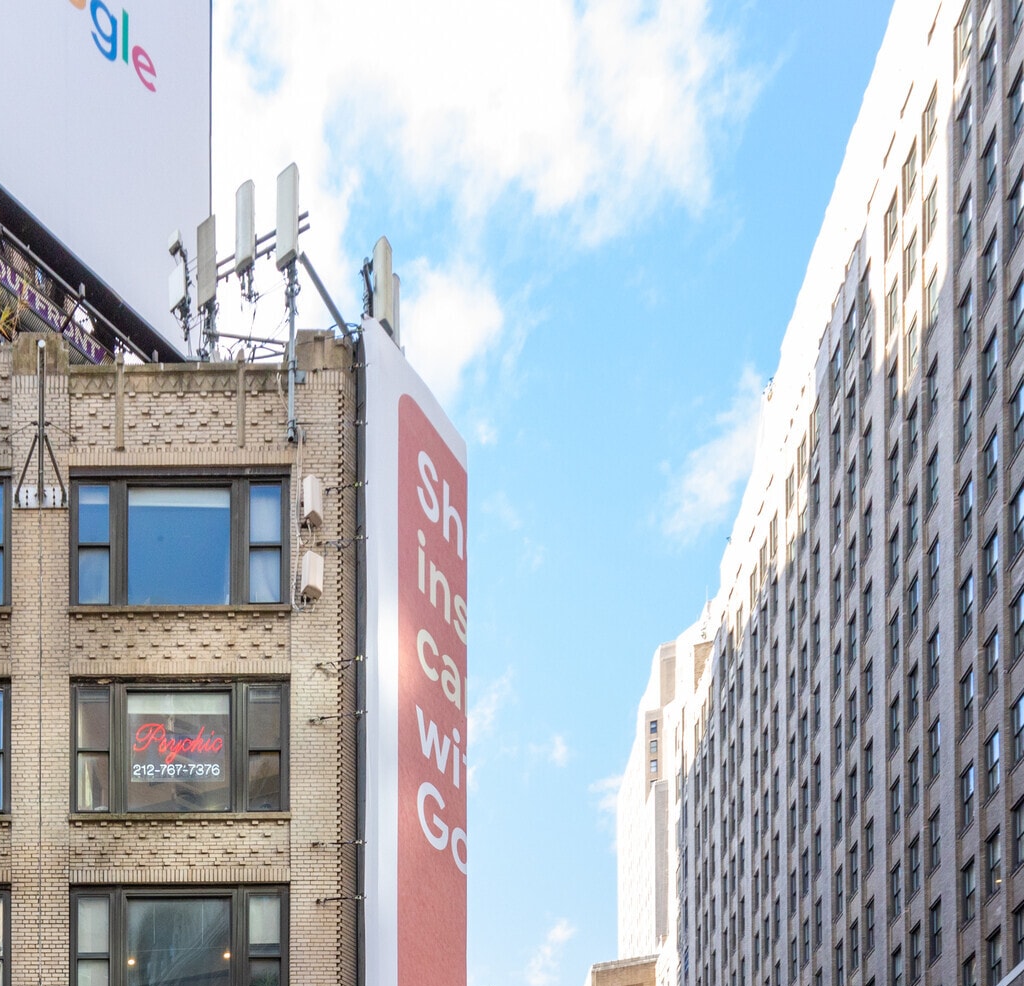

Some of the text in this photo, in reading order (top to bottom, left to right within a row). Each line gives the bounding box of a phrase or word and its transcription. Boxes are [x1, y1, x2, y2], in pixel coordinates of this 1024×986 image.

[69, 0, 157, 92] gle
[416, 450, 464, 561] Sh
[416, 629, 467, 711] ca
[133, 722, 223, 765] Psychic
[133, 763, 221, 776] 212-767-7376
[415, 704, 467, 790] wi
